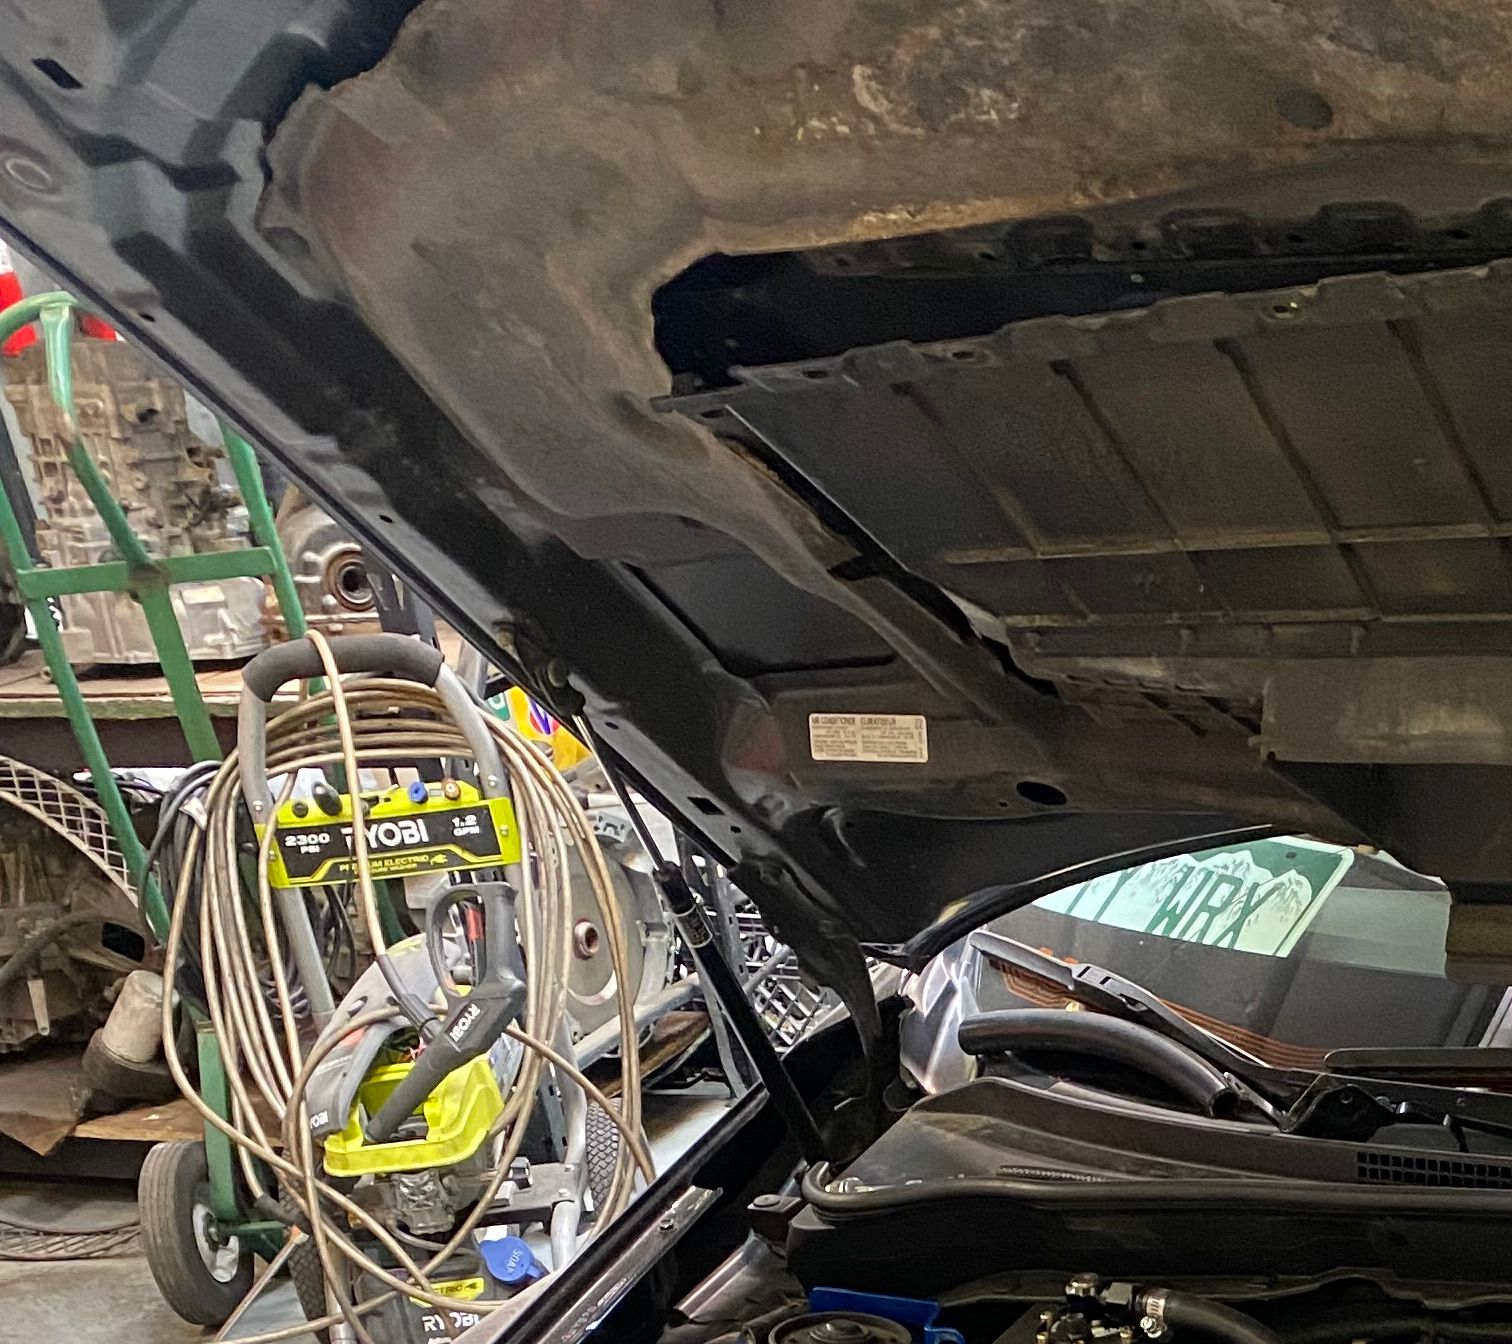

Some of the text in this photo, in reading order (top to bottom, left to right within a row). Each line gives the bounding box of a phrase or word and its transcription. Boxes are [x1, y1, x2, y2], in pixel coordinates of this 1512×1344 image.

[451, 814, 478, 827] 1.2
[284, 833, 331, 847] 2300
[300, 845, 321, 854] PSI
[386, 855, 430, 868] ELECTRIC
[1145, 866, 1286, 949] WRX
[449, 1004, 480, 1042] RYOBI
